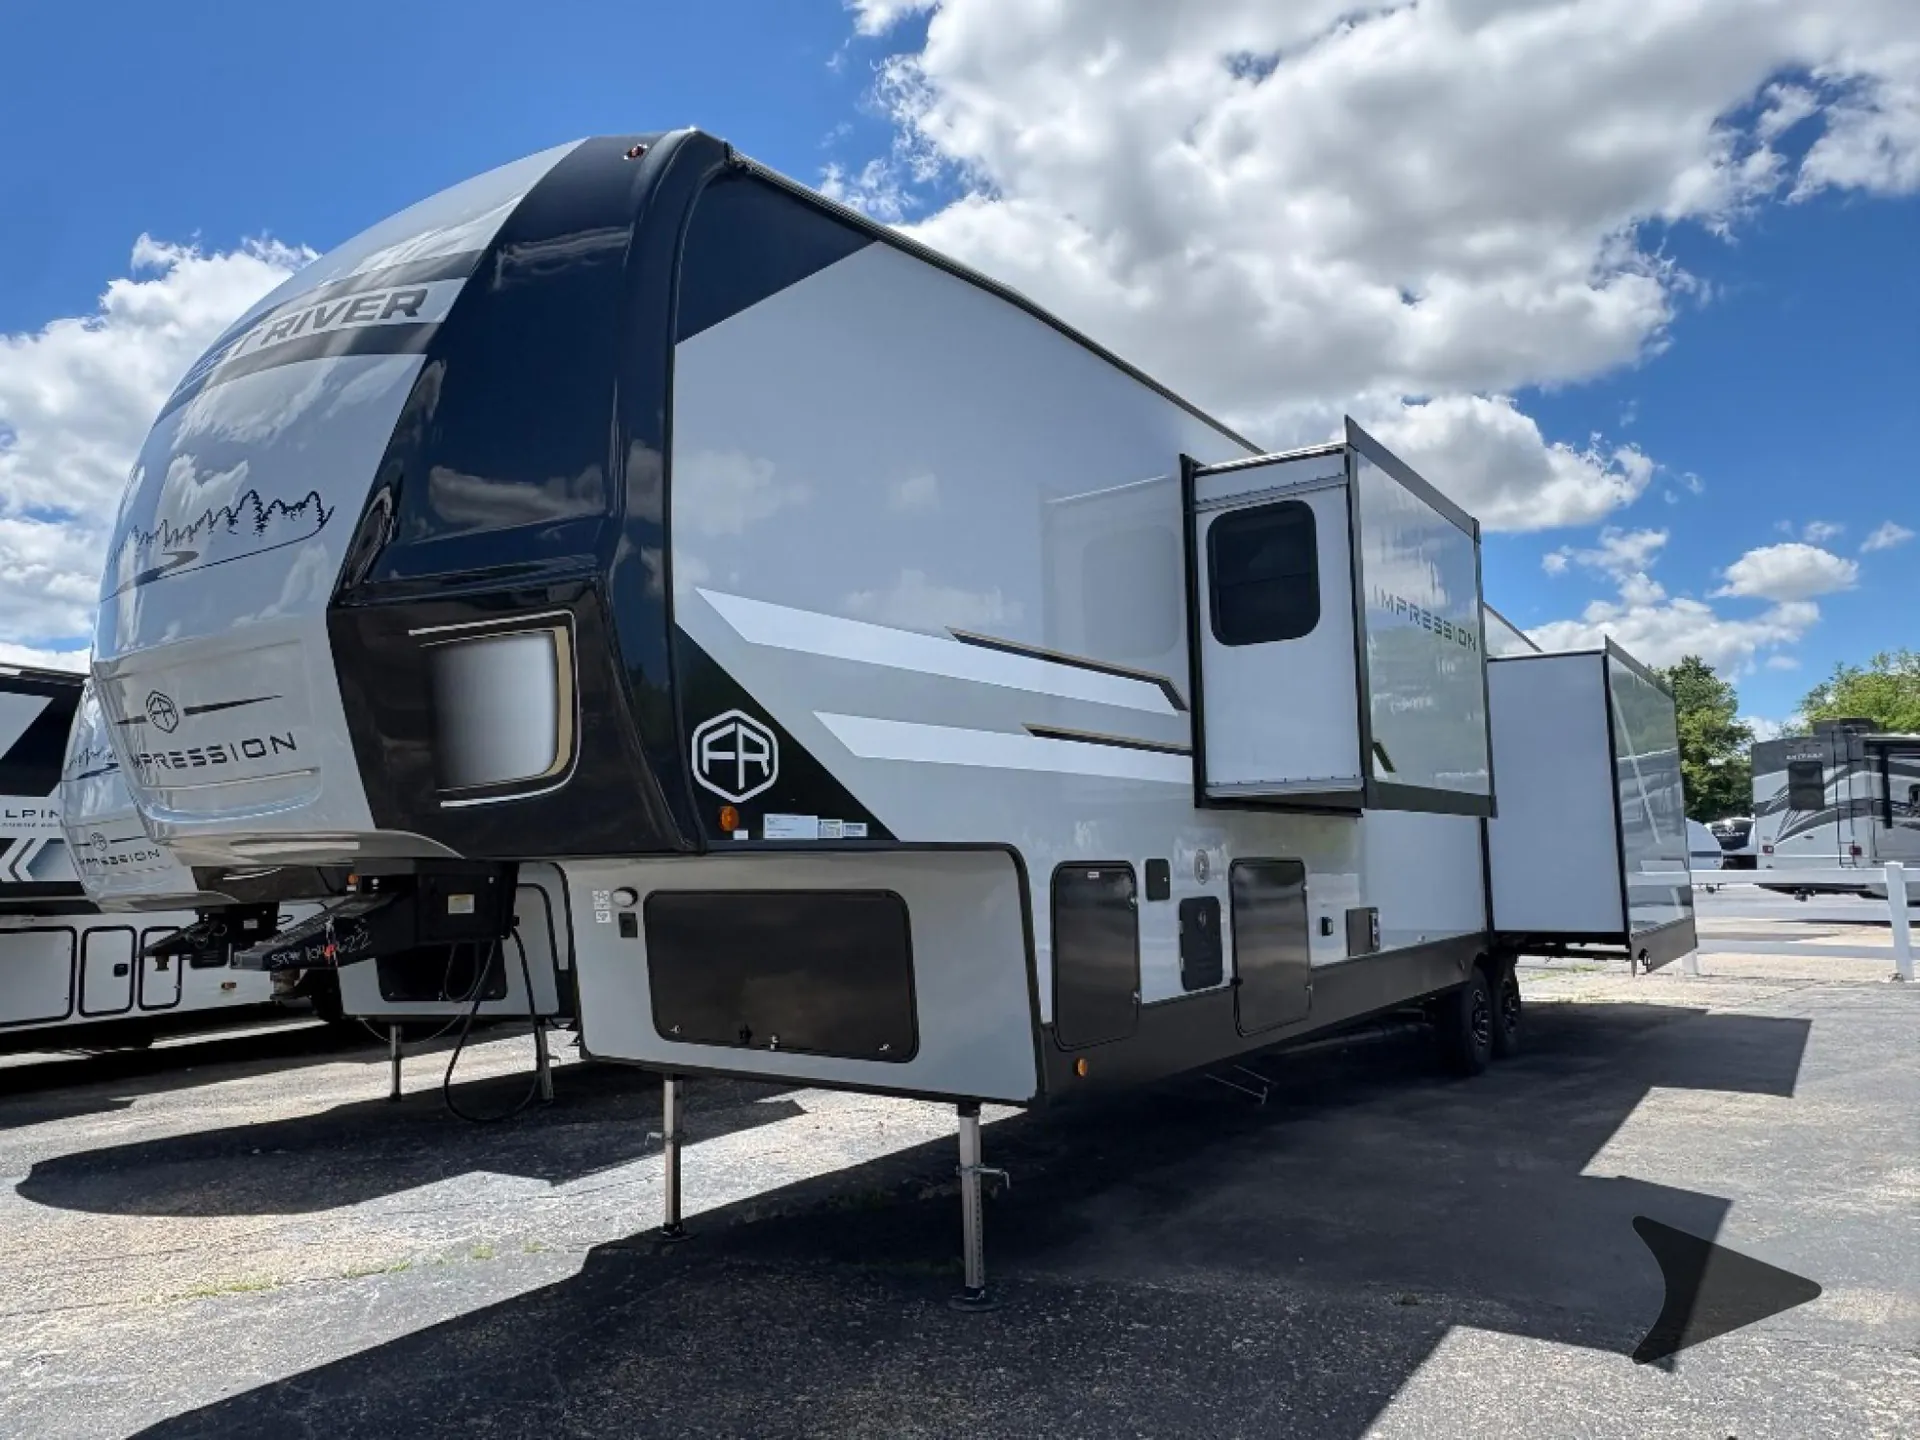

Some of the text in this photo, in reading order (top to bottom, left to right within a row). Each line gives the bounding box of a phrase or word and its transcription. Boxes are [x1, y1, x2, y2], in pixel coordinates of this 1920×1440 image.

[260, 288, 428, 346] RIVER
[1373, 584, 1477, 652] IMPRESSION
[130, 731, 298, 769] PRESSION
[5, 809, 60, 819] LPIN
